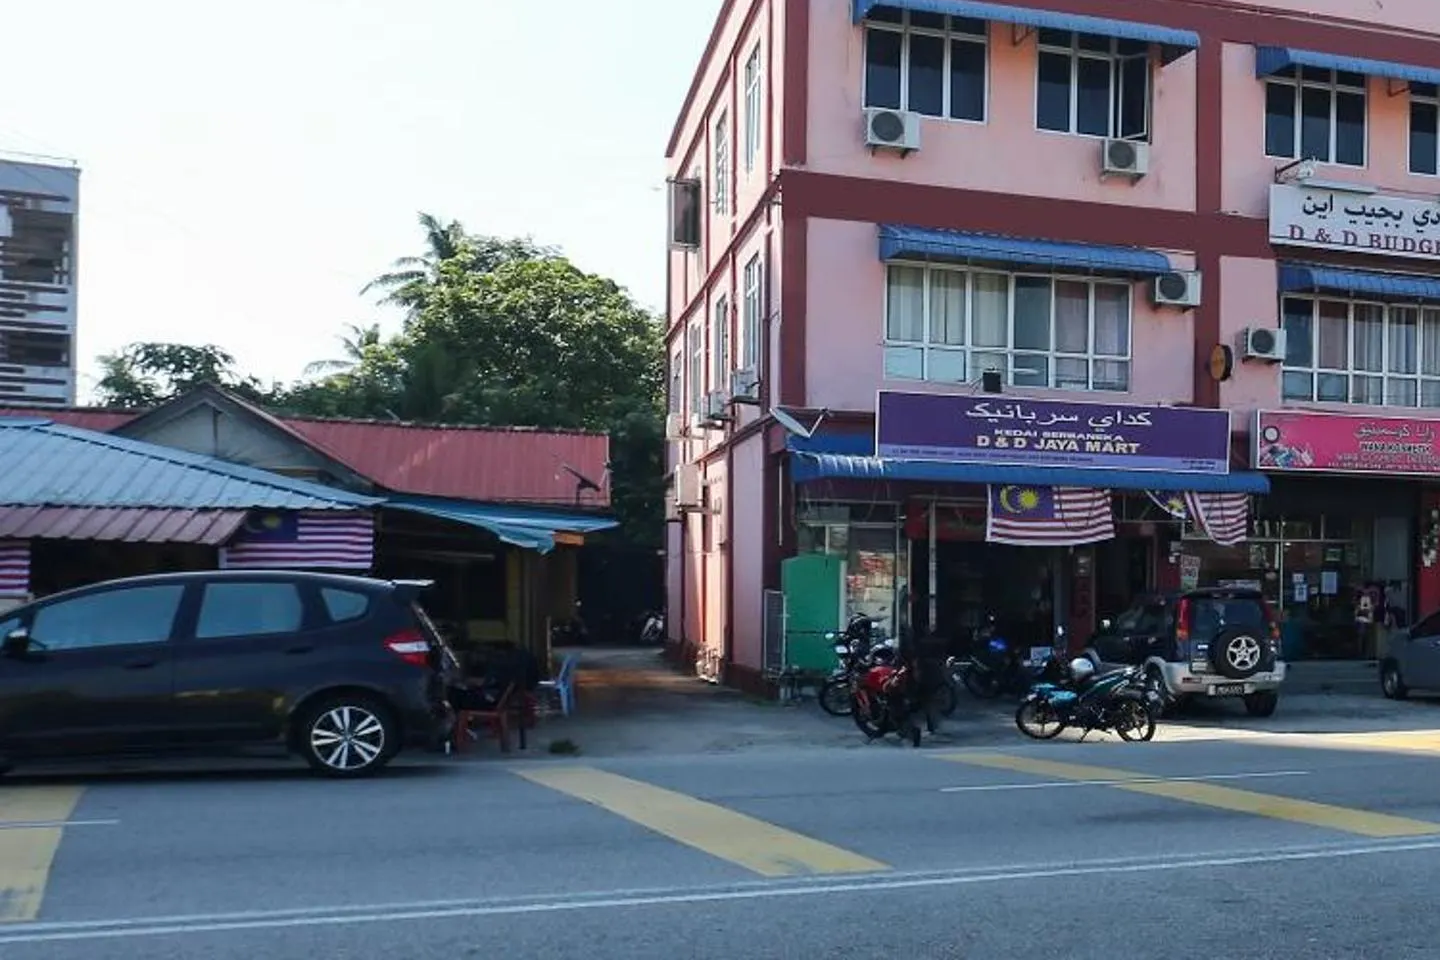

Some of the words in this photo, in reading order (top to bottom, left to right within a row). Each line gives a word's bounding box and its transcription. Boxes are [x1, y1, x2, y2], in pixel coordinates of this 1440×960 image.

[1288, 224, 1304, 241] D
[1314, 227, 1331, 242] &
[1342, 229, 1358, 247] D
[993, 427, 1038, 438] KEDAI
[976, 435, 990, 447] D
[995, 436, 1009, 448] &
[1013, 437, 1027, 449] D
[1033, 439, 1080, 452] JAYA
[1085, 440, 1141, 454] MART
